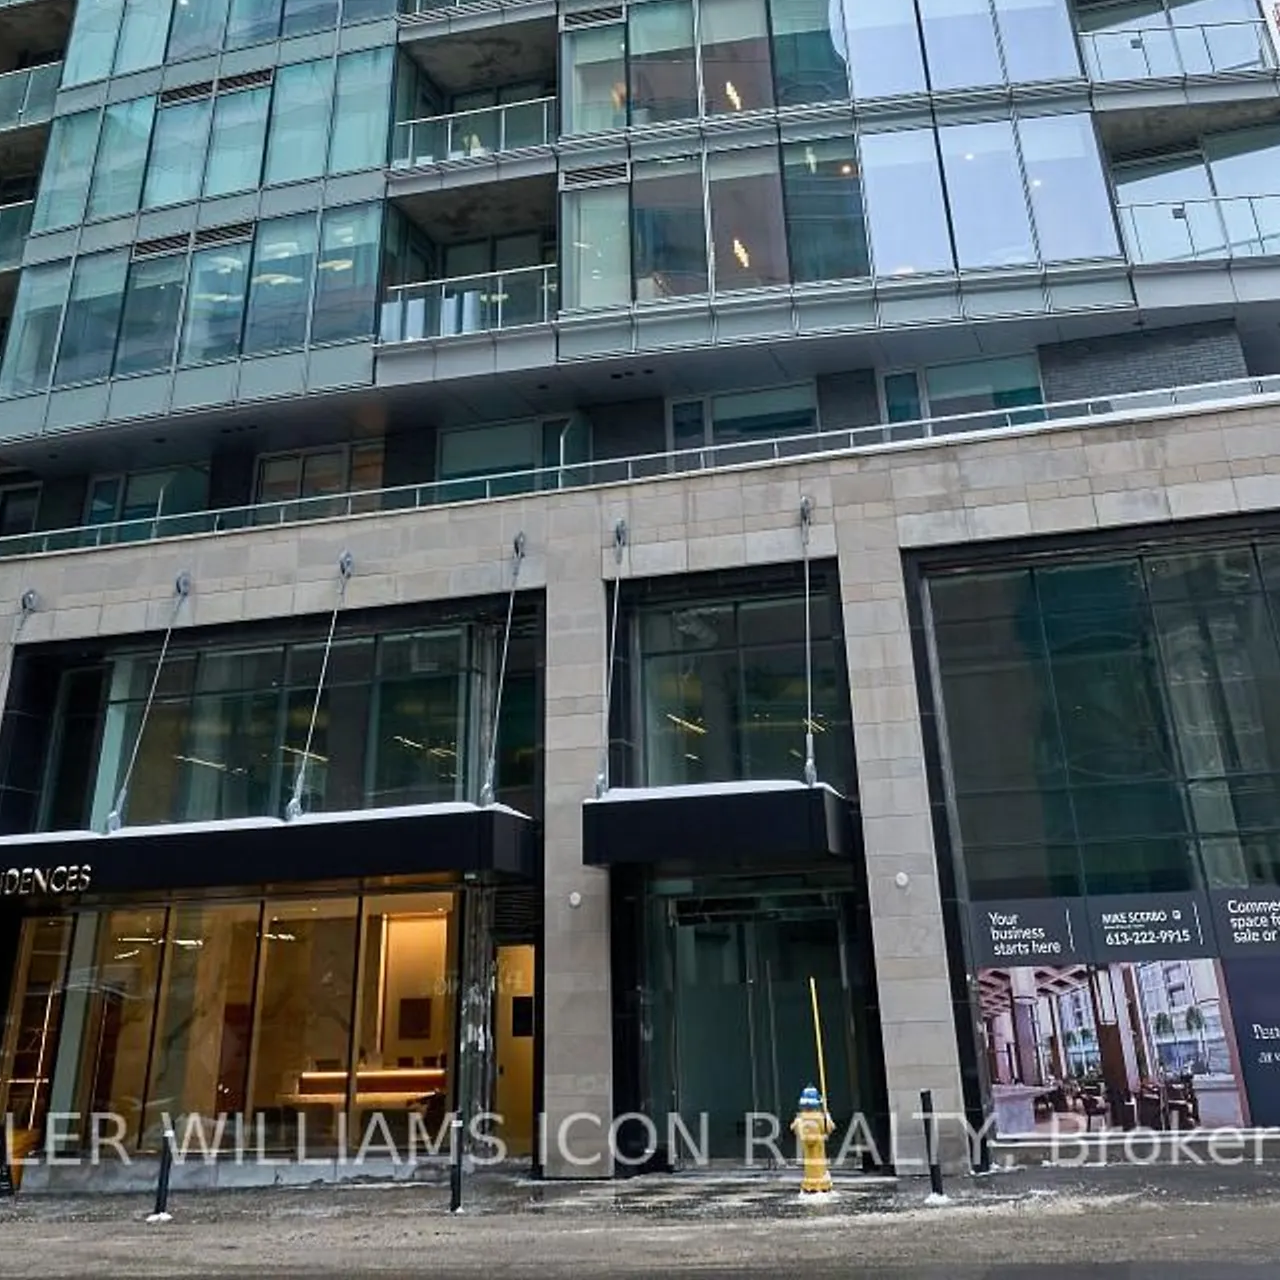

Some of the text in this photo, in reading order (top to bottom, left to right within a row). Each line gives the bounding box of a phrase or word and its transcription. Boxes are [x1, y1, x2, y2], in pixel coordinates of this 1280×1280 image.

[988, 911, 1019, 926] Your
[1230, 916, 1268, 929] space
[991, 926, 1046, 941] business
[1105, 929, 1191, 946] 613-222-9915
[1234, 929, 1260, 943] sale
[1262, 930, 1276, 941] or
[994, 940, 1062, 956] starts here
